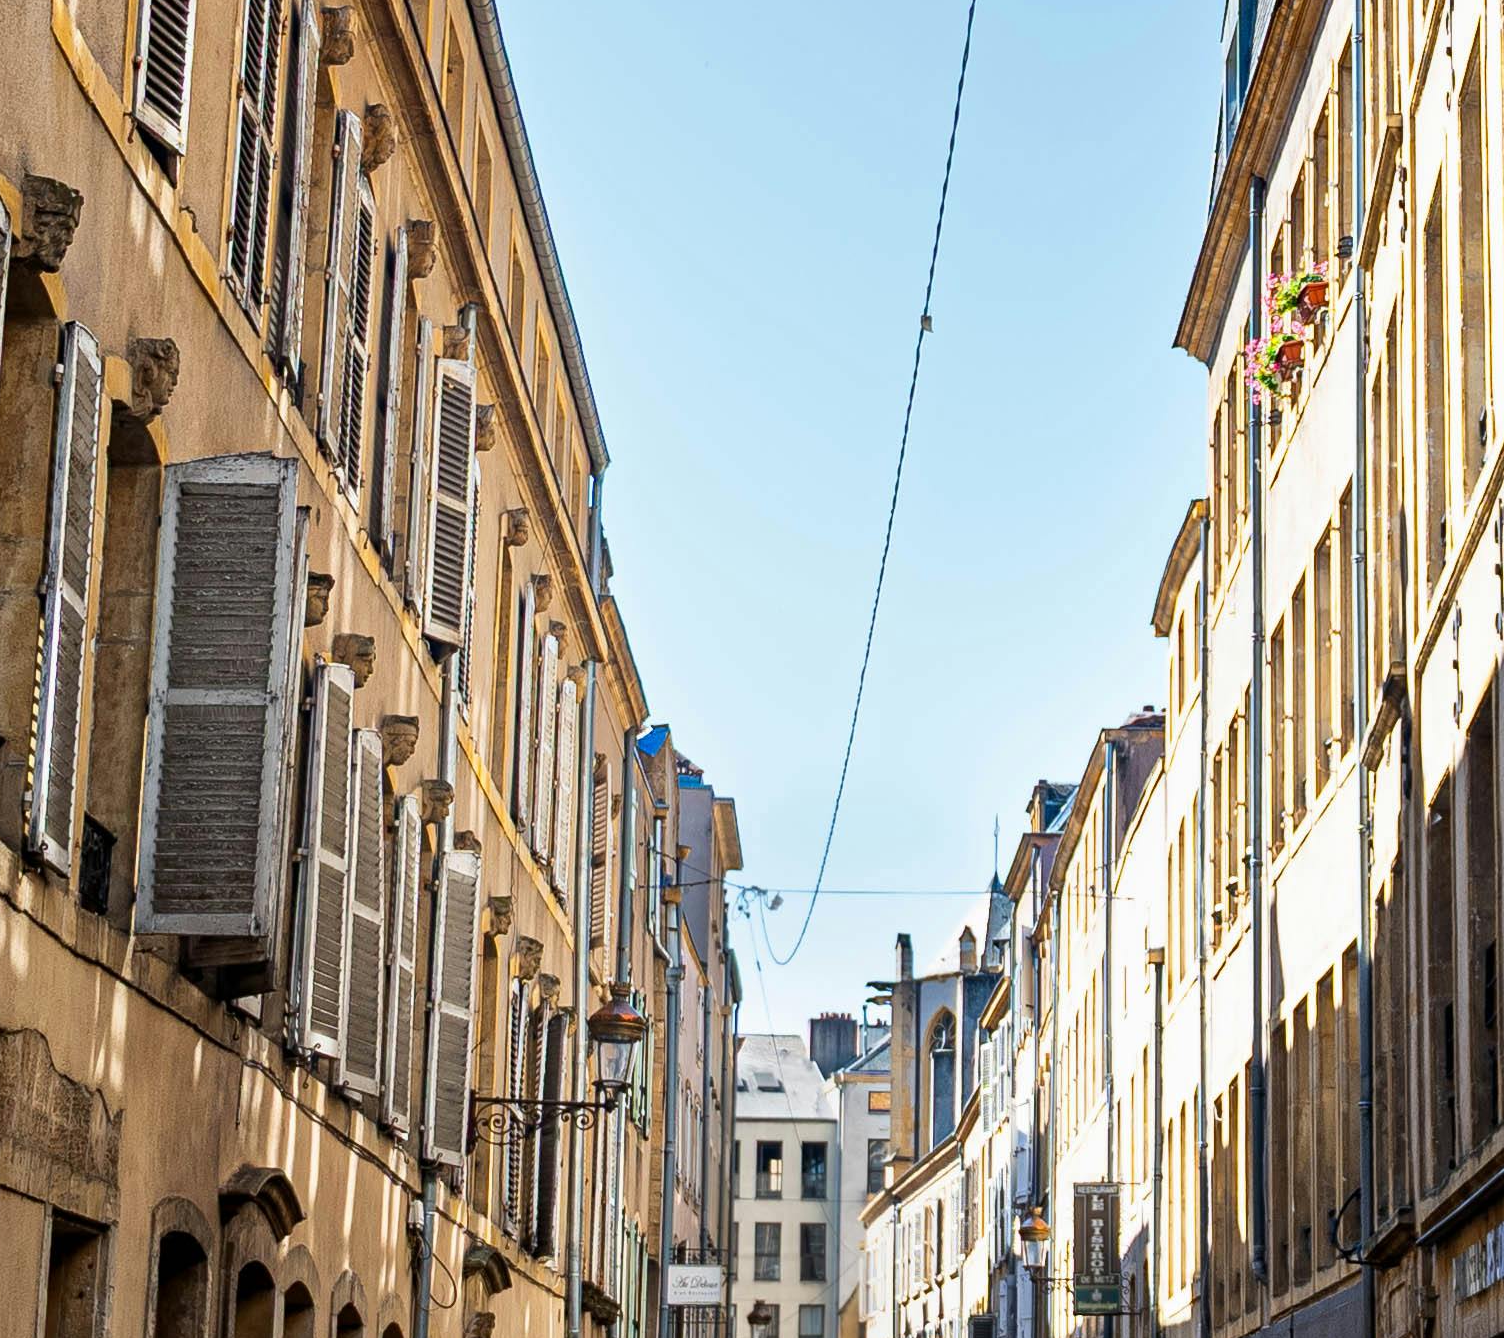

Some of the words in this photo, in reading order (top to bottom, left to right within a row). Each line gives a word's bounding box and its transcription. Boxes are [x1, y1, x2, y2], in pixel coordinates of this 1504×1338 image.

[1091, 1194, 1105, 1211] LE
[1090, 1218, 1105, 1276] BISTROT
[1080, 1275, 1091, 1284] DE
[1094, 1275, 1115, 1284] METZ
